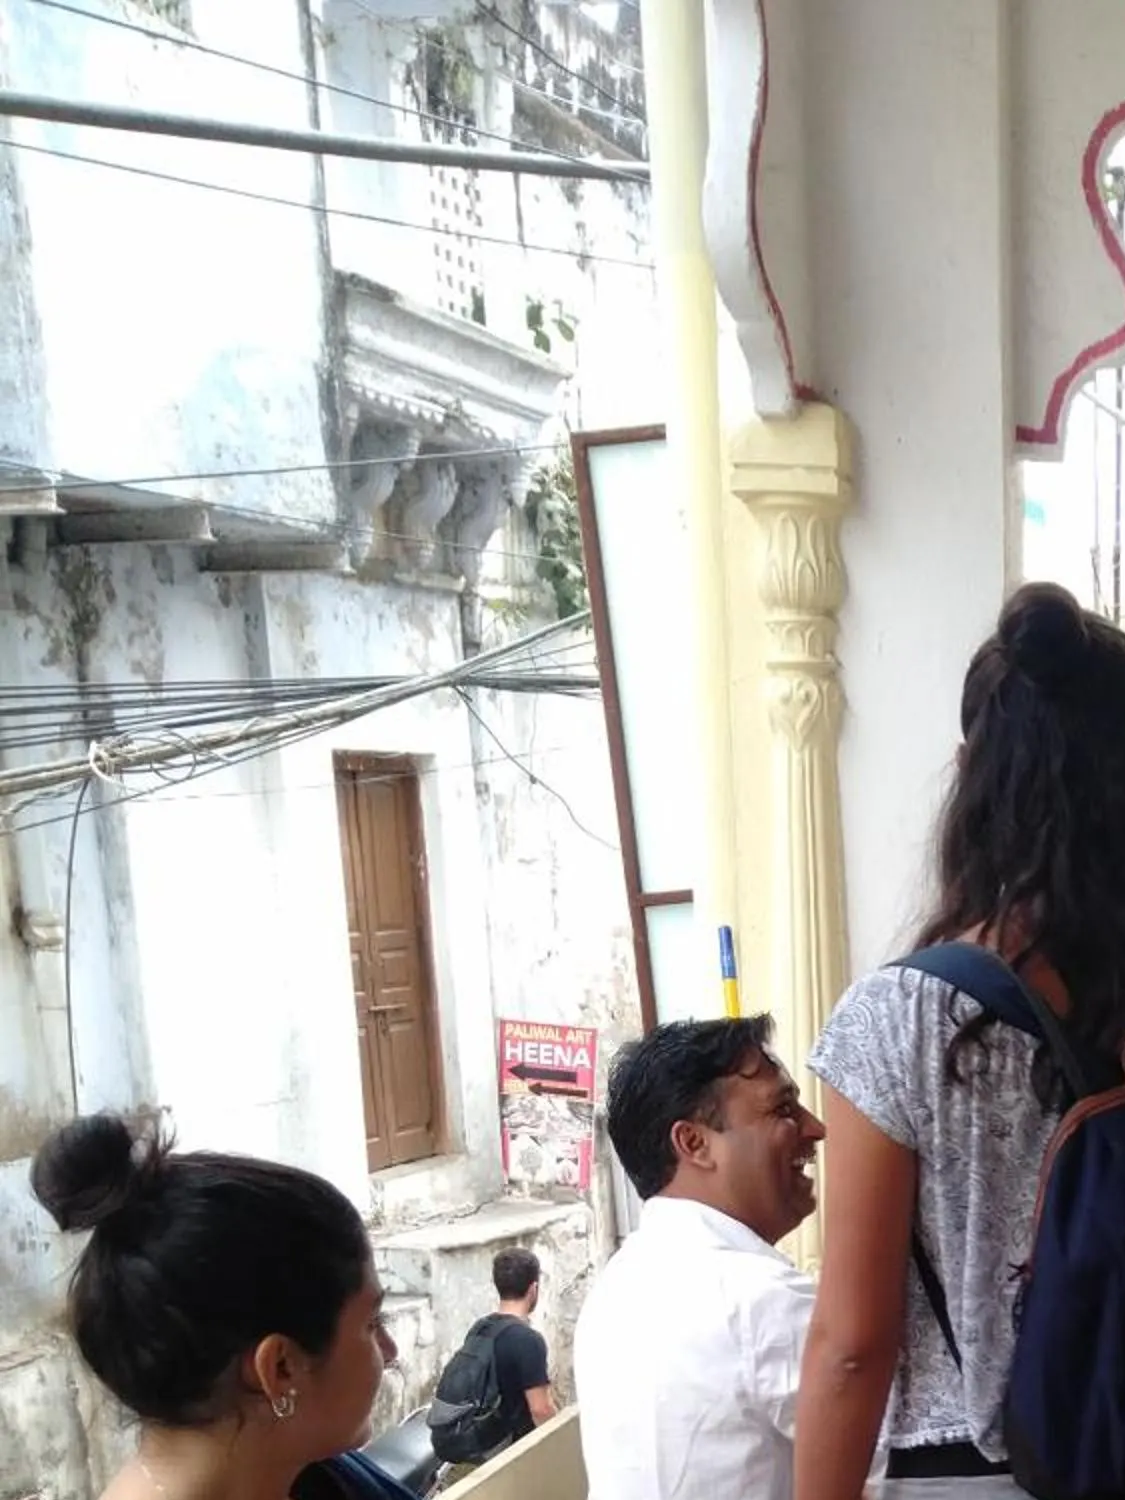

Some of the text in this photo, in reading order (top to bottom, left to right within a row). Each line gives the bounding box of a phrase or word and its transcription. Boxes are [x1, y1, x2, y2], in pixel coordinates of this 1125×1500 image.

[504, 1023, 593, 1046] PALIWAL ART
[504, 1039, 593, 1069] HEENA
